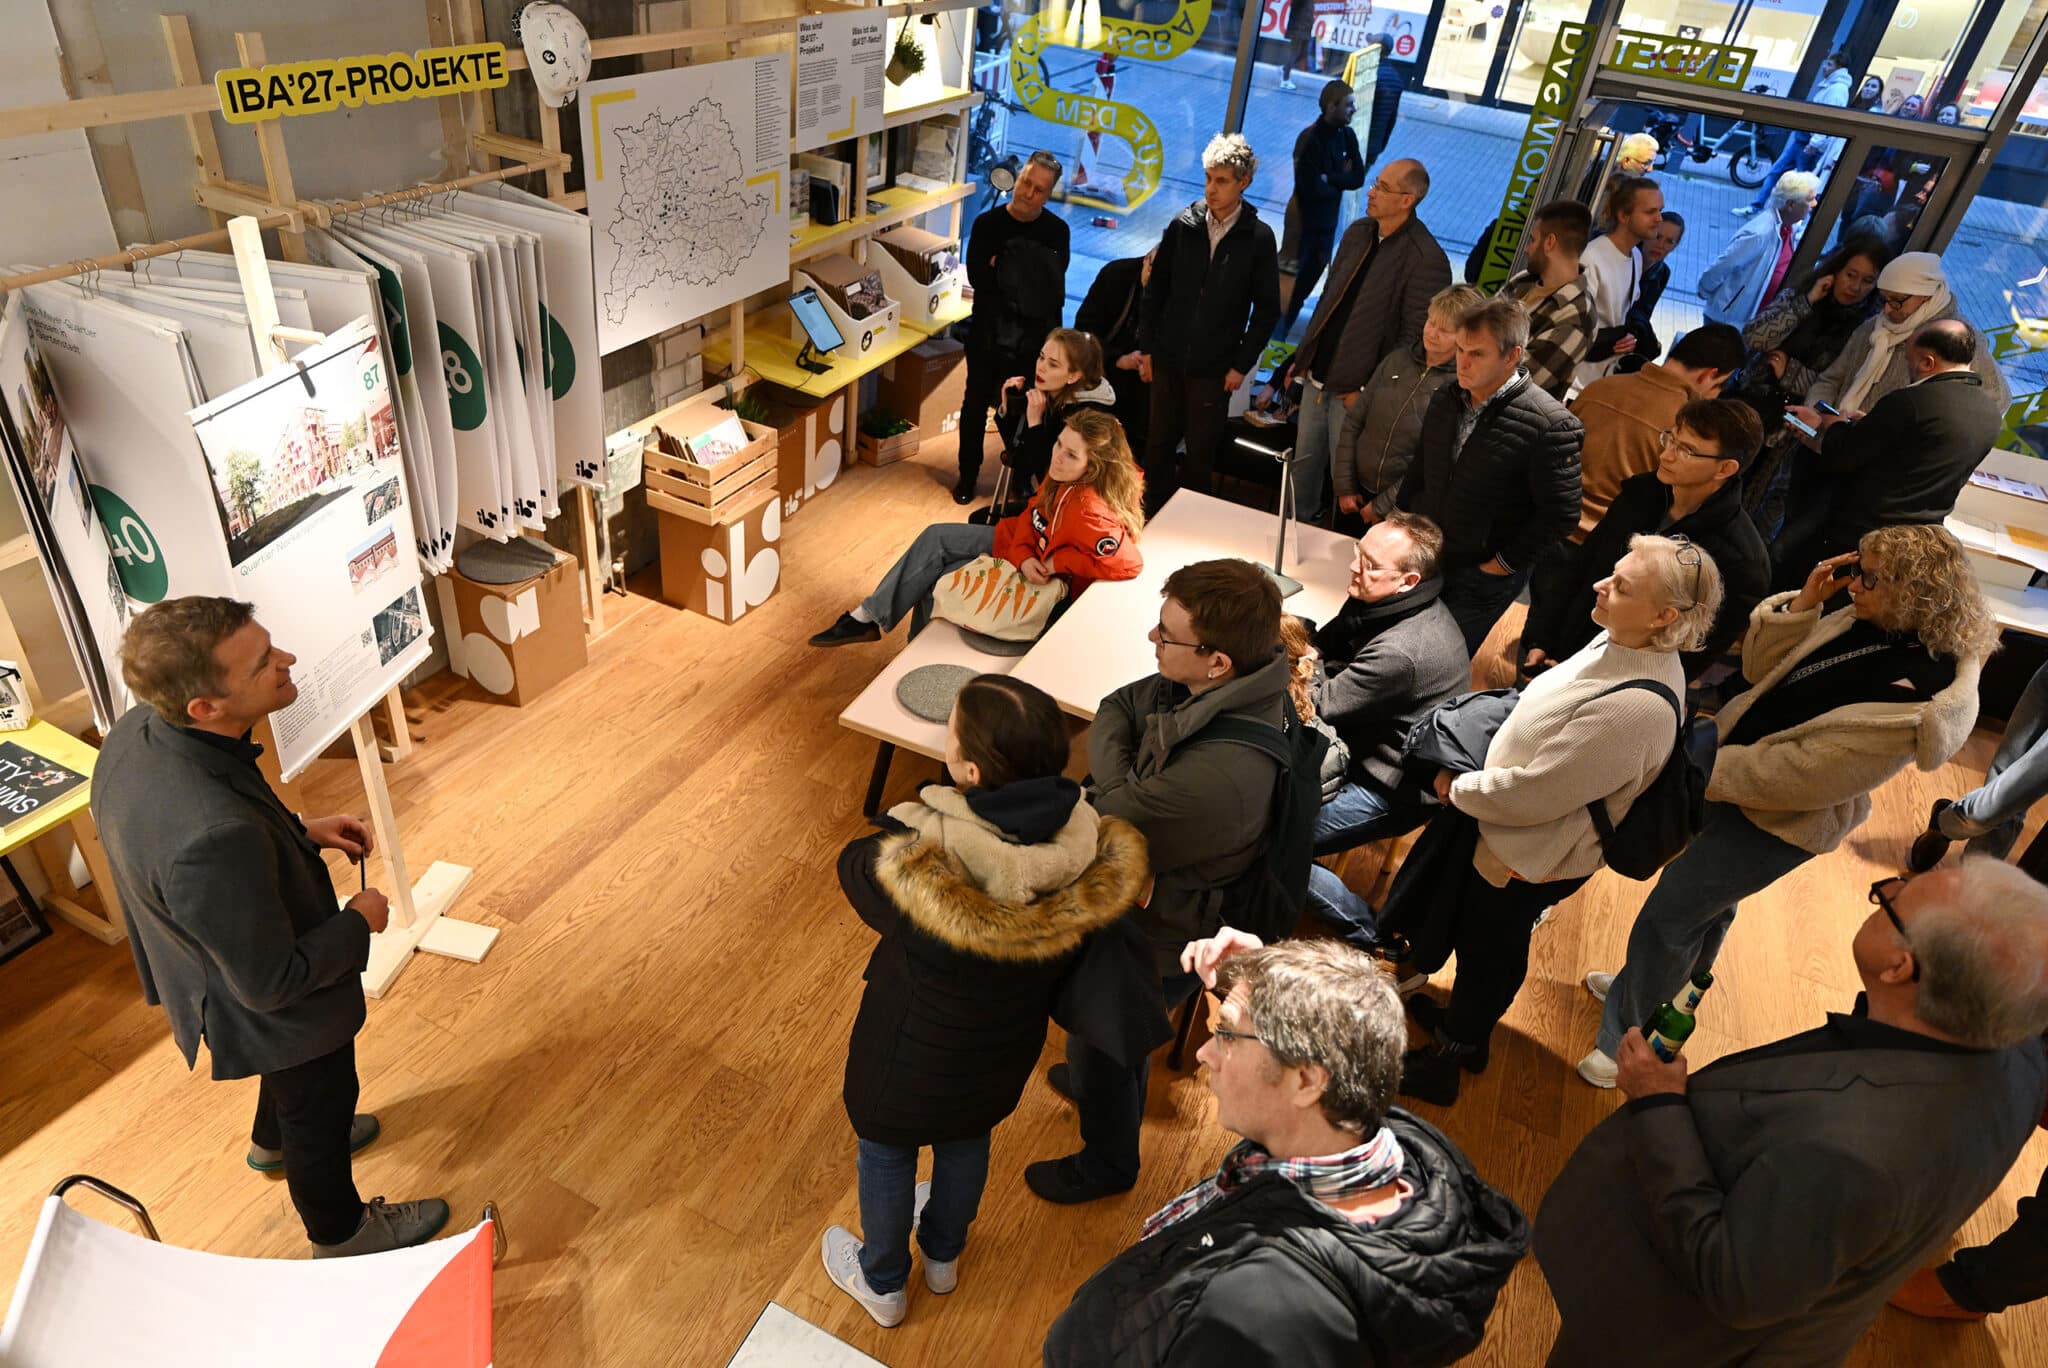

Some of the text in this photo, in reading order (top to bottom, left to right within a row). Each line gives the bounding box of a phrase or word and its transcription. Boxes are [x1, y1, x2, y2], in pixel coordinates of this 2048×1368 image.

[1329, 26, 1371, 49] ALLE
[225, 50, 504, 114] IBA'27-PROJEKTE
[363, 363, 380, 391] 87
